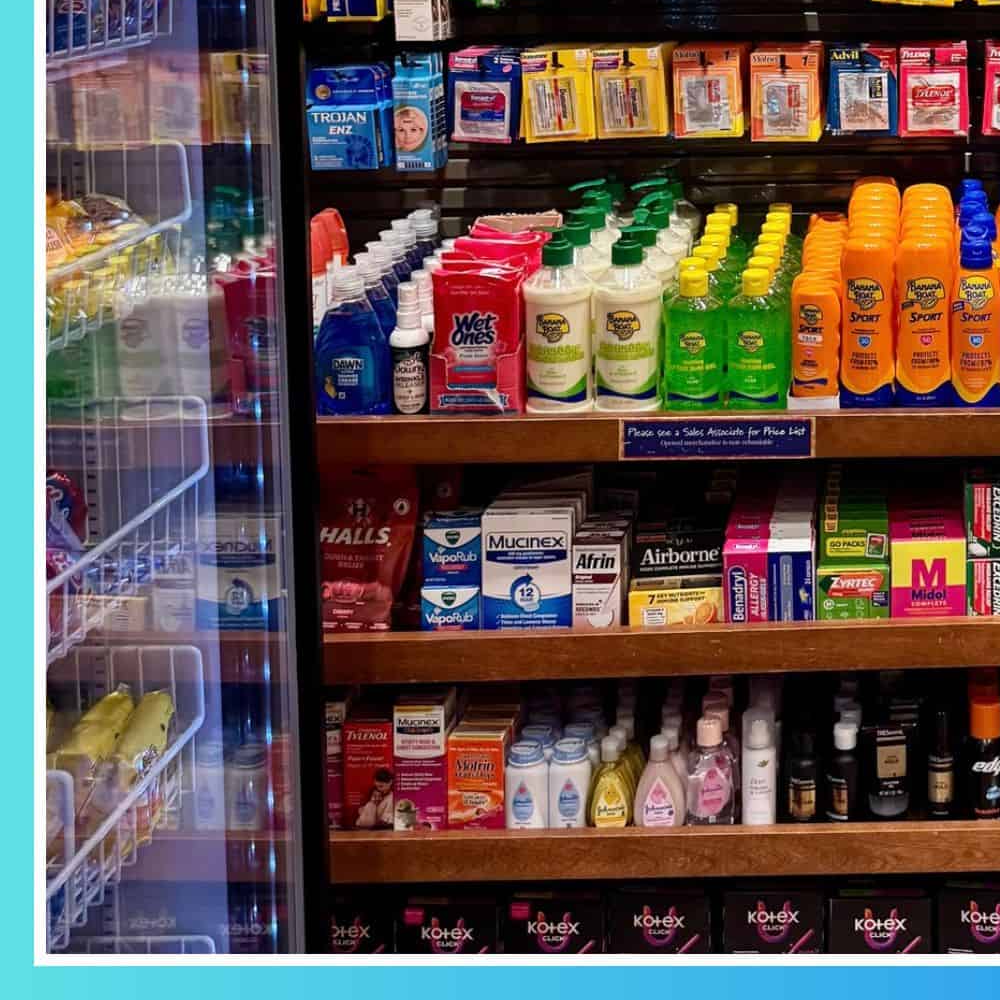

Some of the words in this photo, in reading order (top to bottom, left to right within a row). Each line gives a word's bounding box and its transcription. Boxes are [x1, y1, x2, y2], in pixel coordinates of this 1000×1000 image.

[832, 50, 859, 61] Advil
[311, 111, 367, 124] TROJAN
[329, 125, 353, 135] ENZ
[454, 313, 495, 331] Wet
[849, 311, 880, 323] SPORT
[909, 311, 943, 323] SPORT
[452, 329, 496, 347] Ones
[332, 359, 364, 370] DAWN
[627, 427, 654, 437] Please
[683, 427, 704, 437] Sales
[748, 427, 760, 439] for
[763, 426, 785, 436] Price
[788, 427, 806, 436] List
[319, 527, 391, 546] HALLS
[428, 550, 478, 564] VapoRub
[576, 553, 616, 570] Afrin
[640, 547, 720, 566] Airborne
[911, 558, 947, 588] M
[830, 576, 877, 590] ZYRTEC
[518, 588, 534, 598] 12
[733, 570, 746, 622] Benadryl
[750, 572, 761, 616] ALLERGY
[911, 589, 947, 600] Midol
[346, 730, 388, 741] TYLENOL
[455, 758, 495, 773] Motrin
